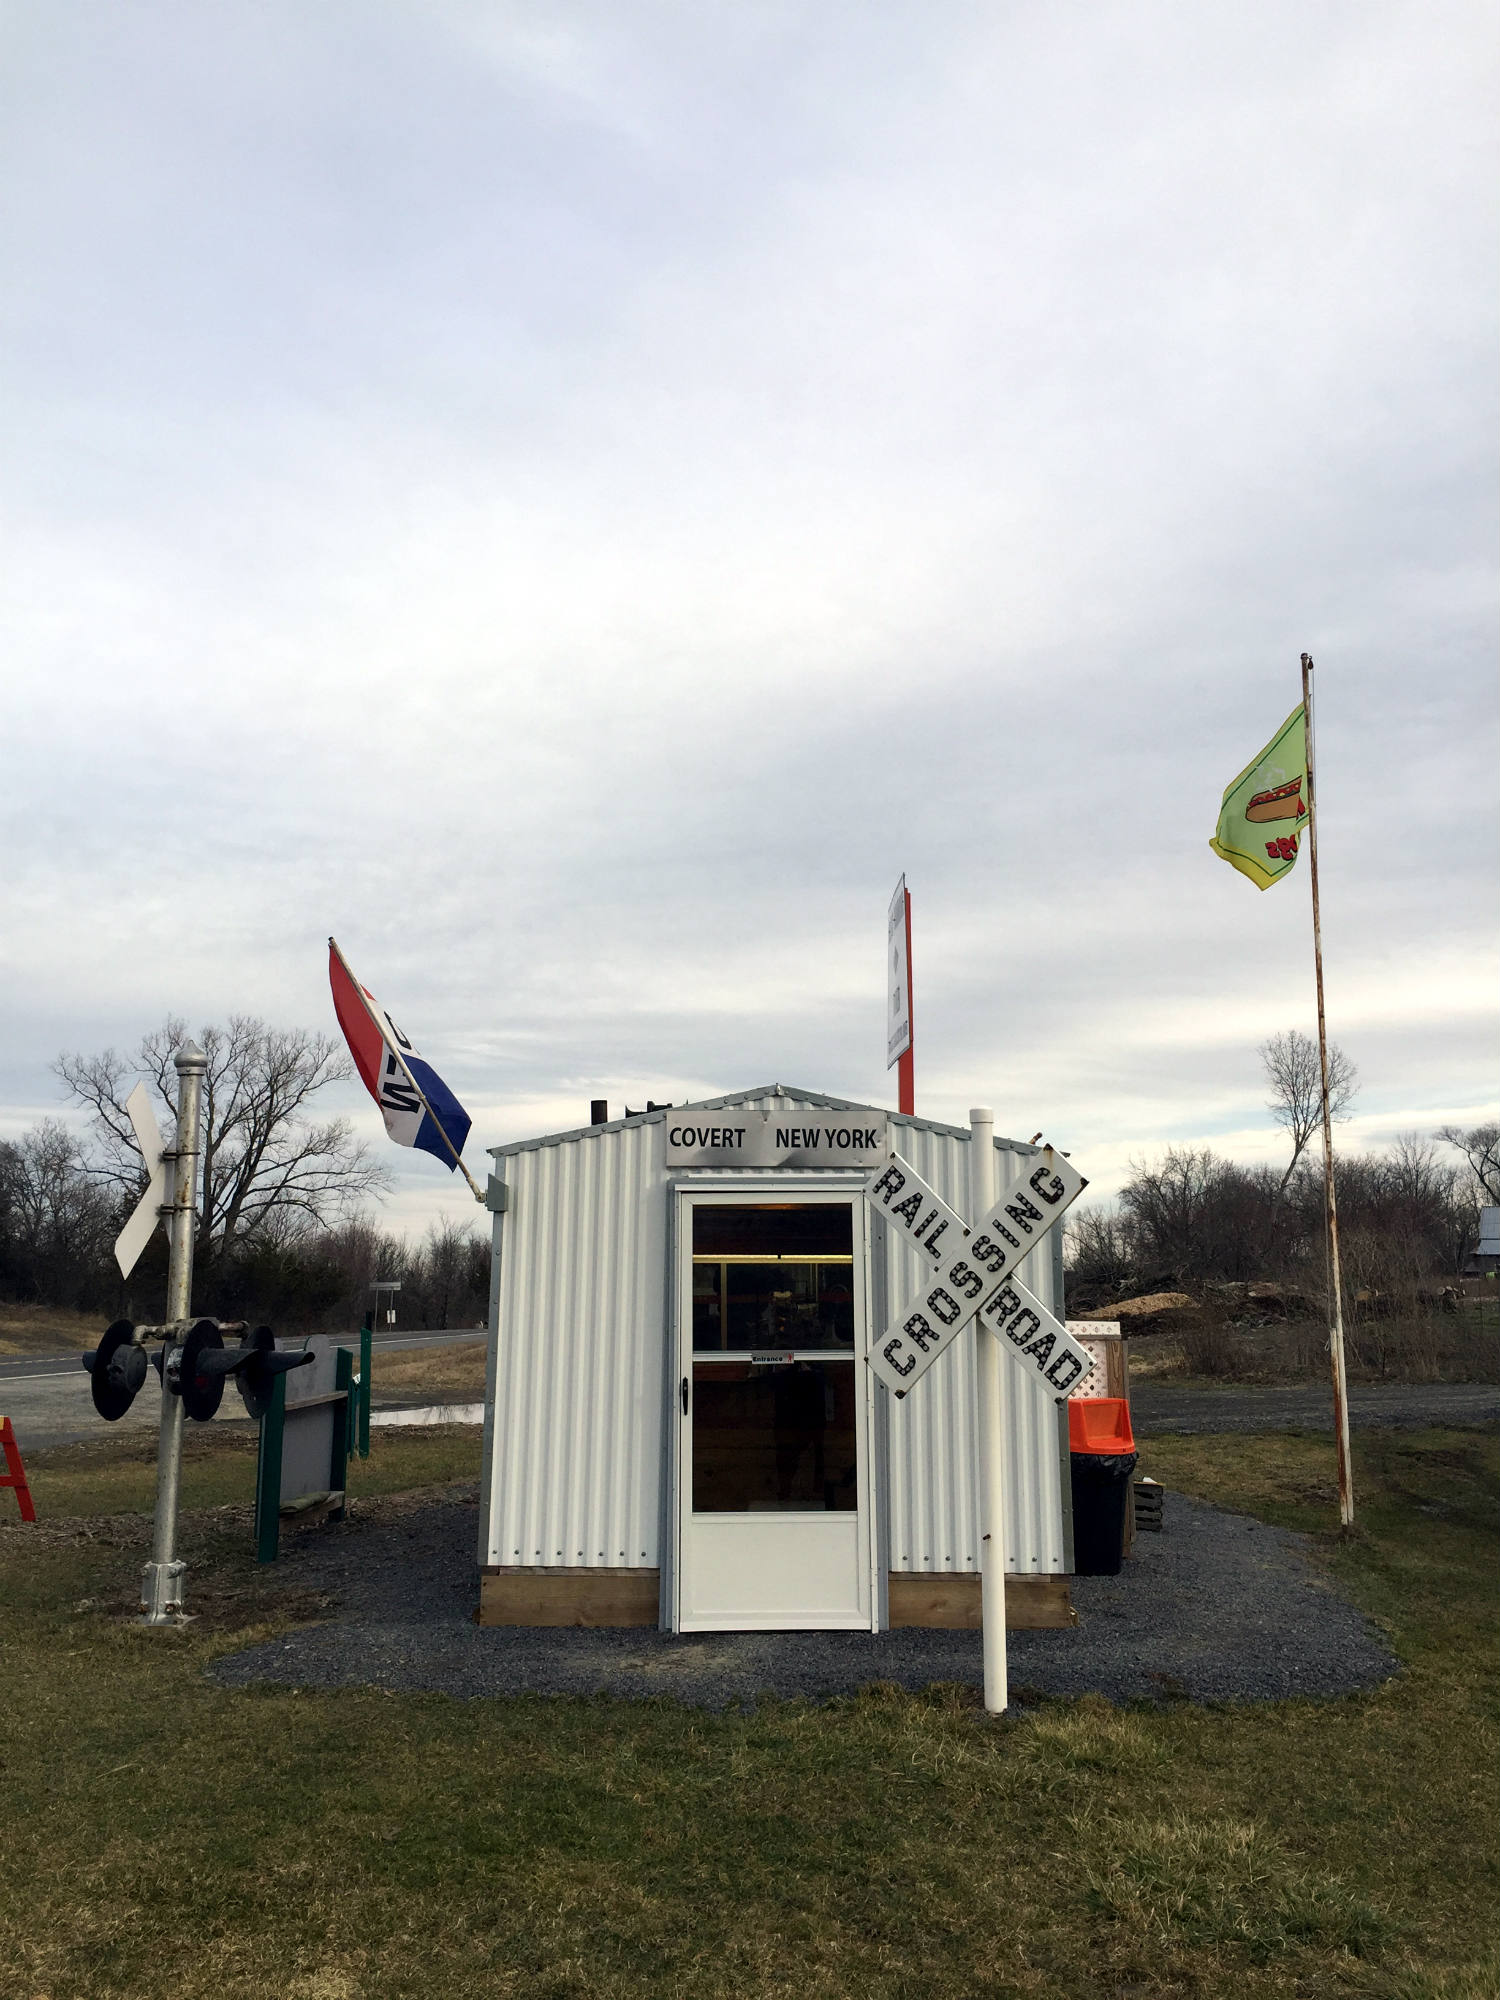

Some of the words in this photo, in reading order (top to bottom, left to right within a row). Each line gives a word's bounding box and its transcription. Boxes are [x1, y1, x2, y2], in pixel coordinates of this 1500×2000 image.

[669, 1127, 746, 1148] COVERT
[776, 1128, 820, 1149] NEW
[824, 1128, 878, 1149] YORK
[872, 1165, 949, 1259] RAIL
[985, 1285, 1083, 1391] ROAD
[883, 1166, 1065, 1376] CROSSING
